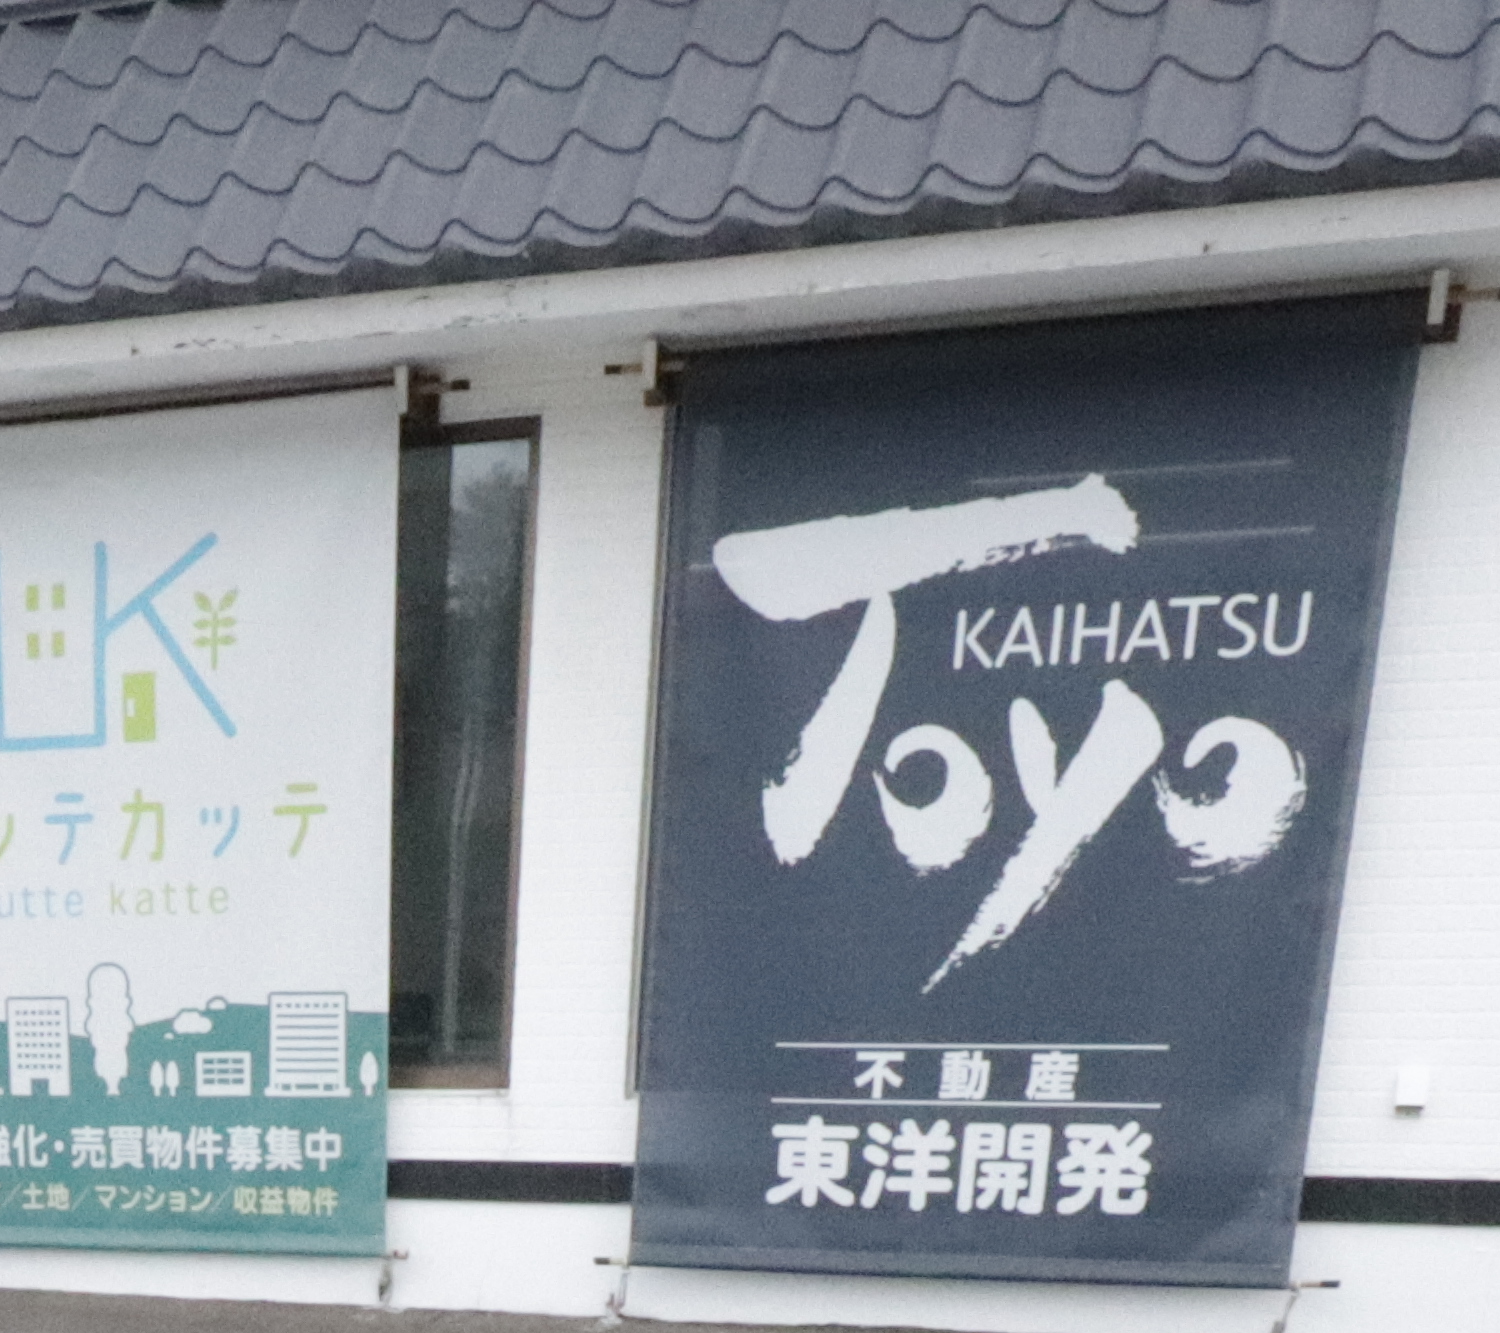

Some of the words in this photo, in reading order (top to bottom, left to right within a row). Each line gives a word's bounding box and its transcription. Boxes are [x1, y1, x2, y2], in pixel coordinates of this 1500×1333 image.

[953, 591, 1313, 670] KAIHATSU
[713, 472, 1308, 993] Toyo
[108, 882, 230, 916] katte
[854, 1051, 1080, 1101] 不動産
[765, 1114, 1153, 1216] 東洋開発
